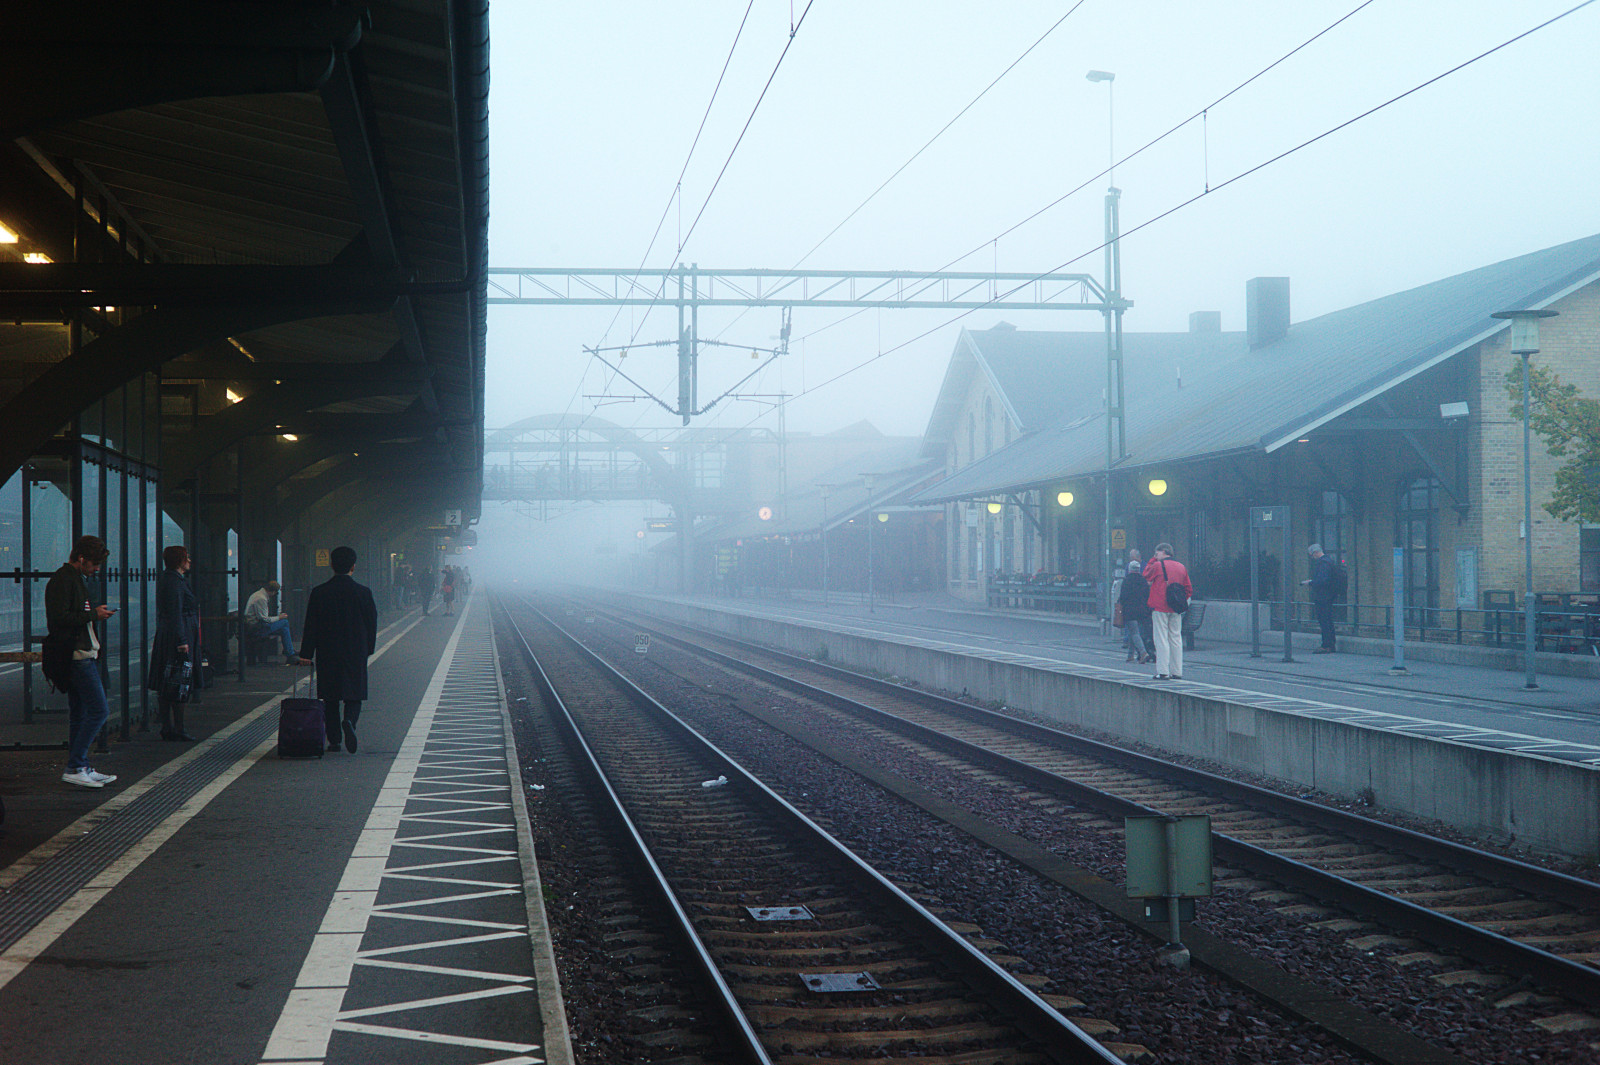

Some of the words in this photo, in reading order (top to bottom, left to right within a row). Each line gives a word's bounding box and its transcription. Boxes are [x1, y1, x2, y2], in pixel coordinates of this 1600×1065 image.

[450, 514, 457, 523] 2
[1262, 510, 1272, 520] Lund
[634, 634, 649, 645] 050
